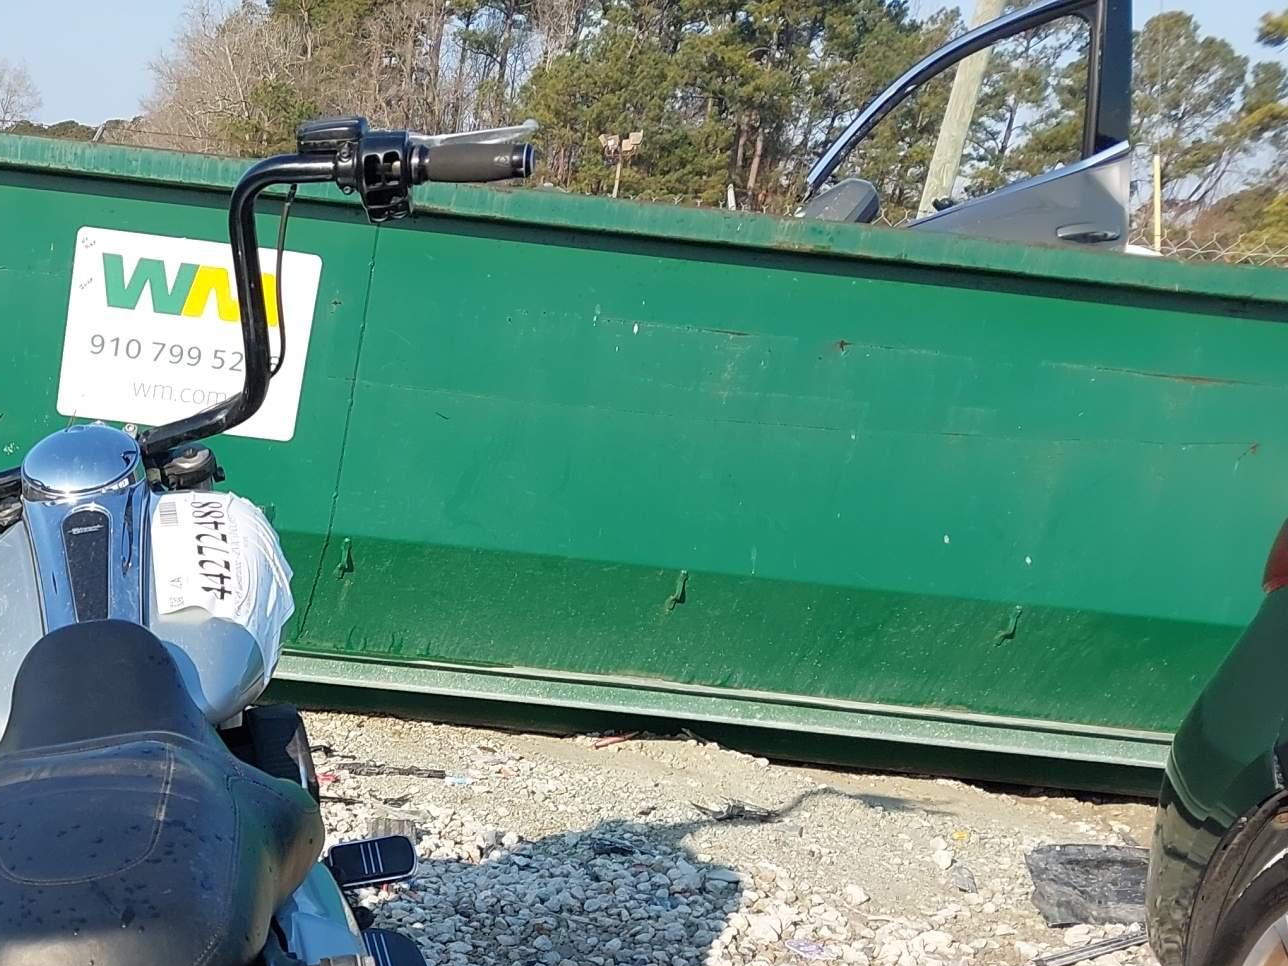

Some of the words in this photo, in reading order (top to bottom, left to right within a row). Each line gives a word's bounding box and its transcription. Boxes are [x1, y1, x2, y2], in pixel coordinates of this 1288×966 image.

[102, 252, 280, 327] WM
[90, 334, 142, 359] 910
[152, 341, 202, 367] 799
[133, 382, 227, 406] wm.com
[190, 501, 232, 600] 44272488
